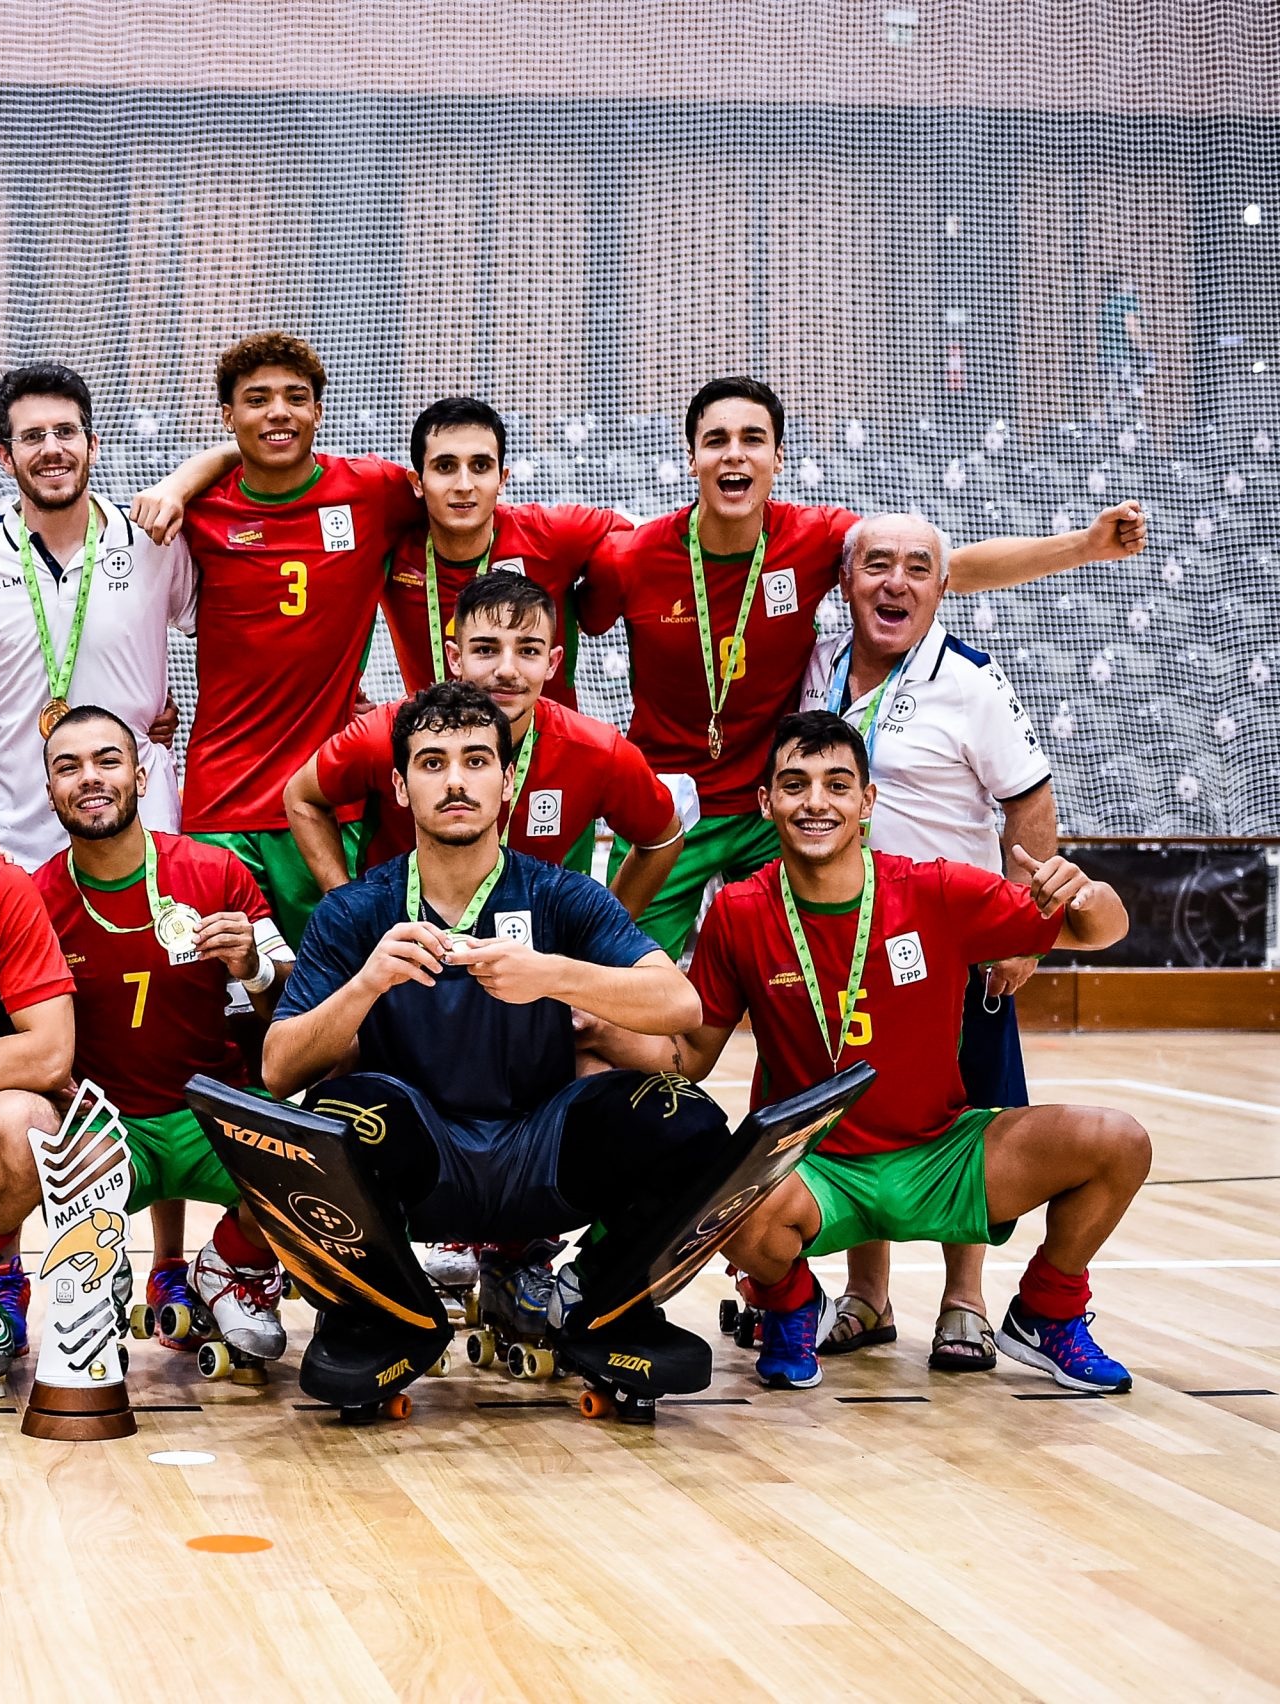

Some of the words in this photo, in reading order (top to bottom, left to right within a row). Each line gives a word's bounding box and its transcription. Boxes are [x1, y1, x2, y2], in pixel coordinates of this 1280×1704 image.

[330, 540, 350, 550] FPP
[108, 582, 129, 591] FPP
[279, 561, 308, 616] 3
[773, 603, 793, 615] FPP
[719, 636, 746, 680] 8
[881, 722, 904, 734] FPP
[533, 825, 554, 835] FPP
[176, 951, 197, 962] FPP
[900, 969, 921, 983] FPP
[123, 971, 151, 1028] 7
[837, 988, 873, 1046] 5
[54, 1194, 93, 1229] MALE
[94, 1172, 124, 1200] U-19
[319, 1239, 367, 1259] FPP
